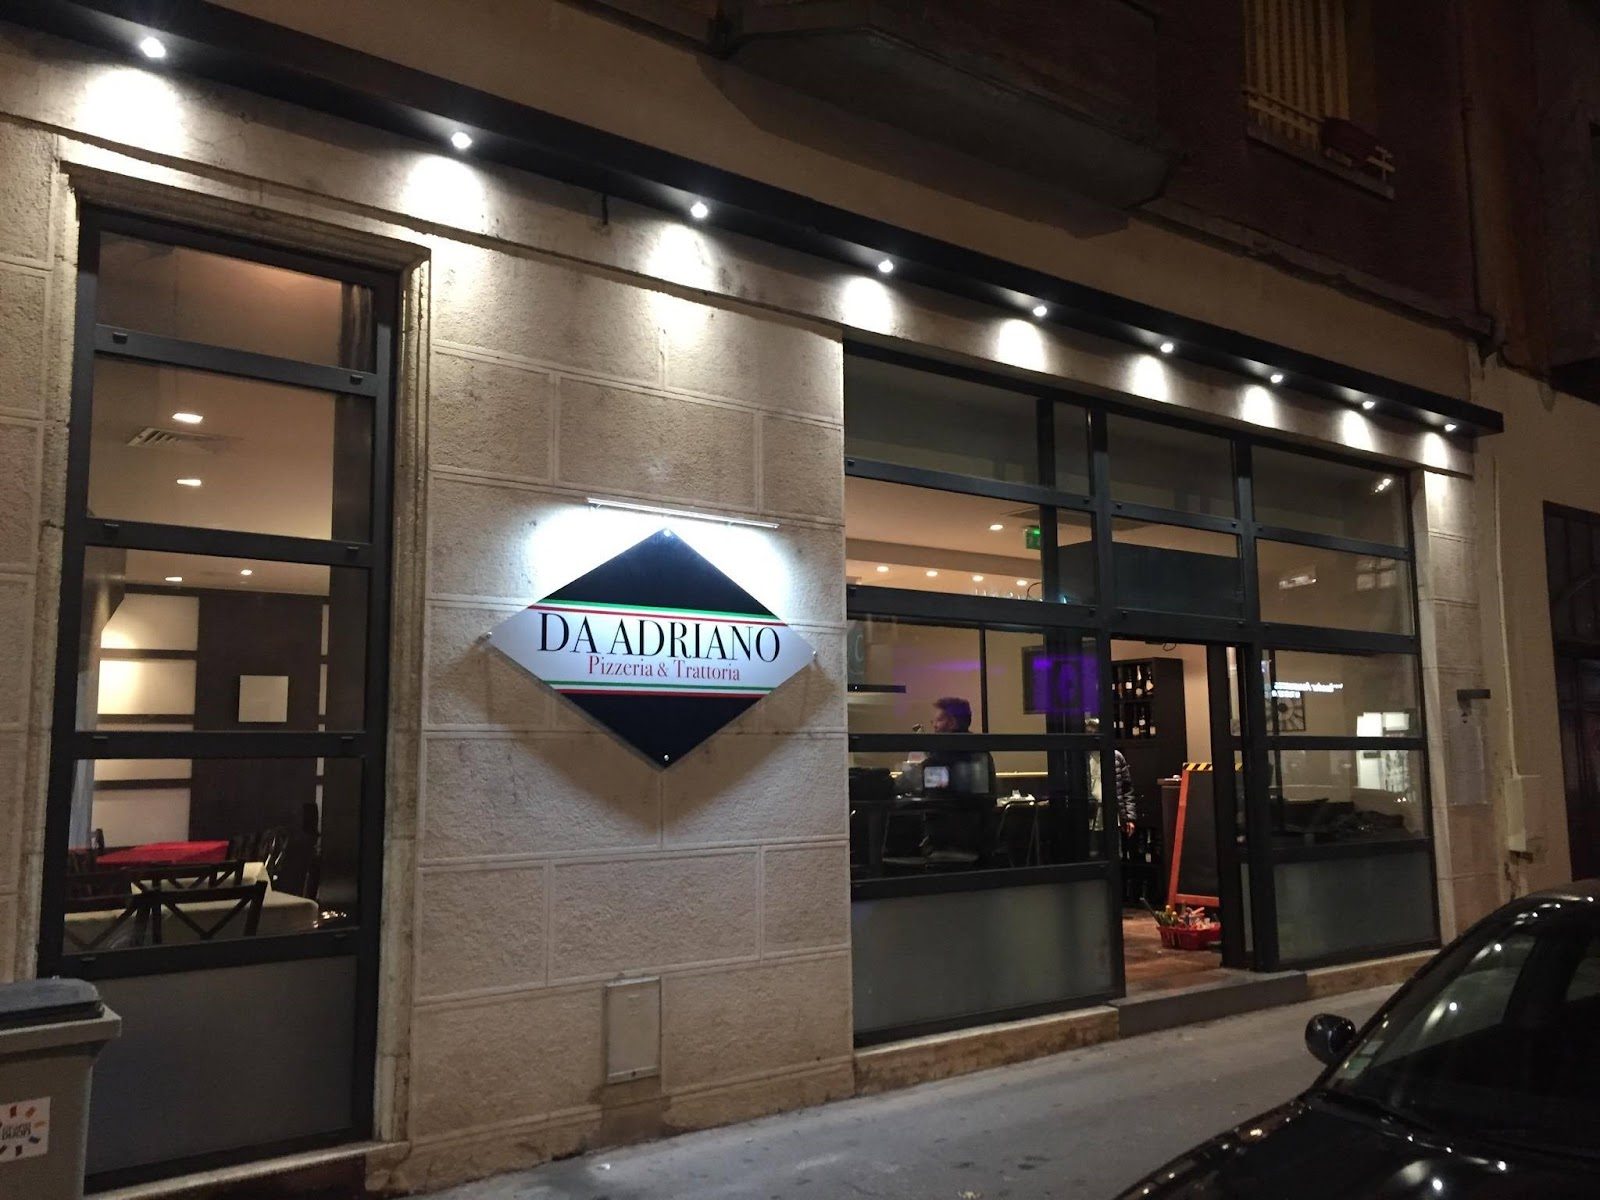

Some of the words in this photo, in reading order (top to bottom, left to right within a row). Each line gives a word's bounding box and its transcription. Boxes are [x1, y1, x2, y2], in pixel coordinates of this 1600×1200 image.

[537, 612, 599, 653] DA
[606, 618, 780, 663] ADRIANO
[589, 656, 653, 677] Pizzeria
[657, 662, 669, 677] &
[673, 660, 740, 681] Trattoria
